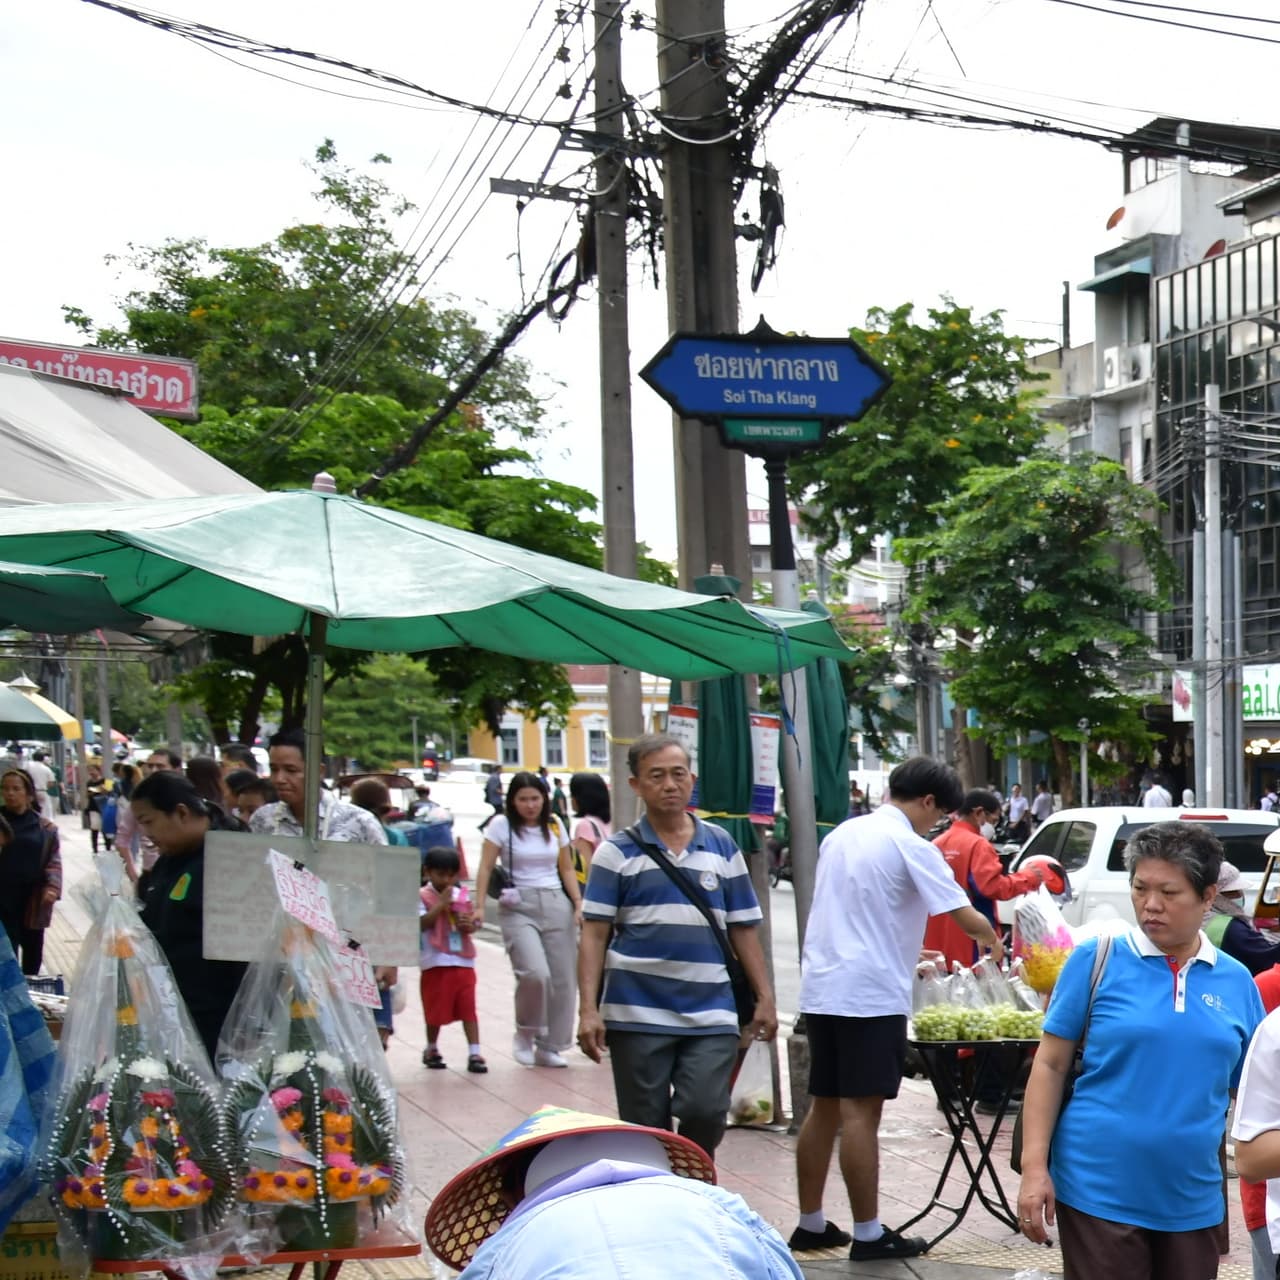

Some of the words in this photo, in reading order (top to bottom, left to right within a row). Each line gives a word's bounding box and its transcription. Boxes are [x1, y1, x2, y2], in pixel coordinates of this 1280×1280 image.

[693, 348, 840, 382] ซอยท่ากลาง
[723, 389, 746, 403] Soi
[749, 390, 774, 404] Tha
[776, 391, 817, 408] Klang
